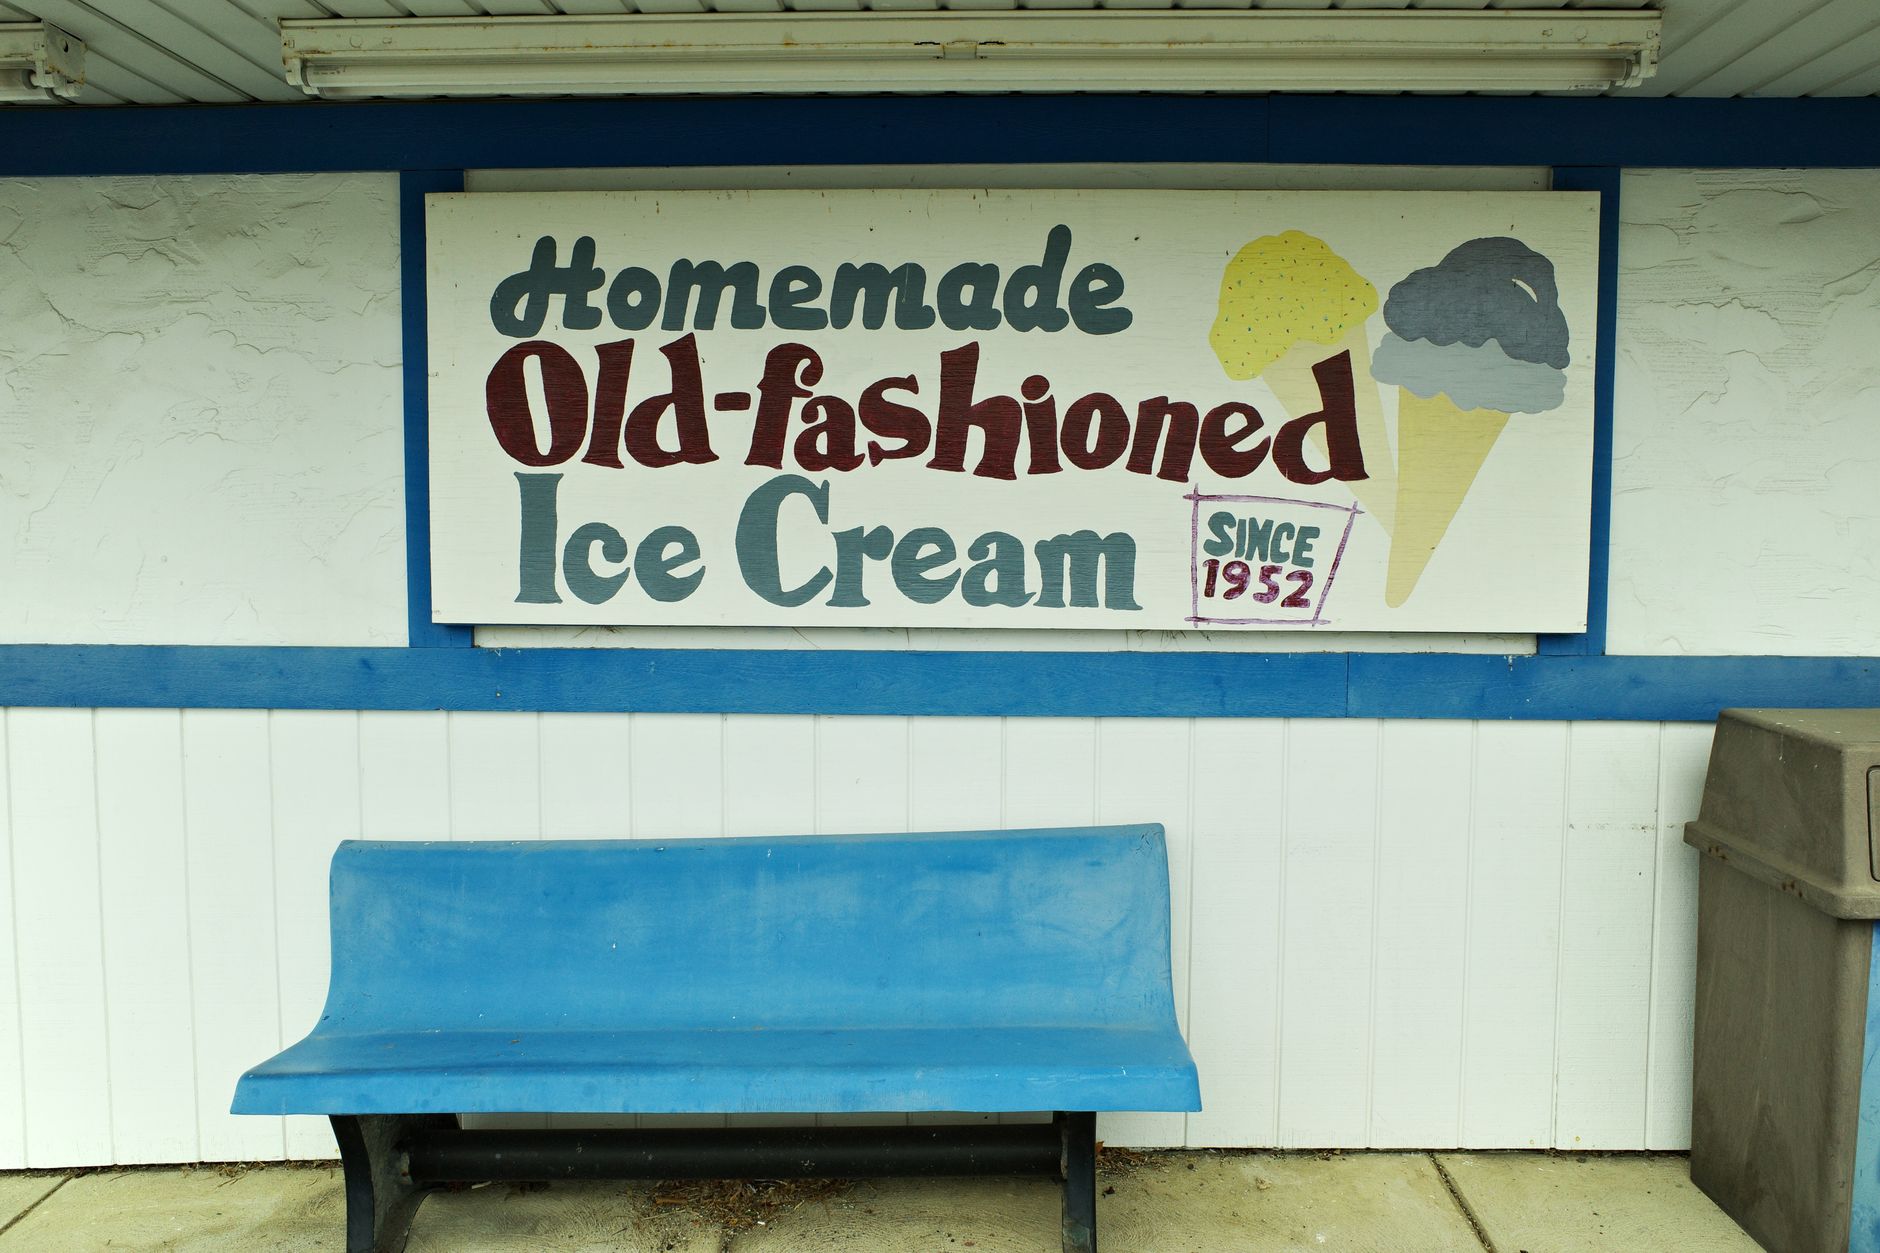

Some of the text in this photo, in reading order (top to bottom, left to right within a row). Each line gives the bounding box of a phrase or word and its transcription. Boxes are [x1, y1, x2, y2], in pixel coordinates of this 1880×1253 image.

[490, 224, 1133, 333] Homemade
[486, 334, 1367, 484] Old-fashioned
[514, 472, 1143, 611] Ice Cream
[1202, 558, 1313, 608] 1952
[1203, 511, 1320, 568] SINCE
